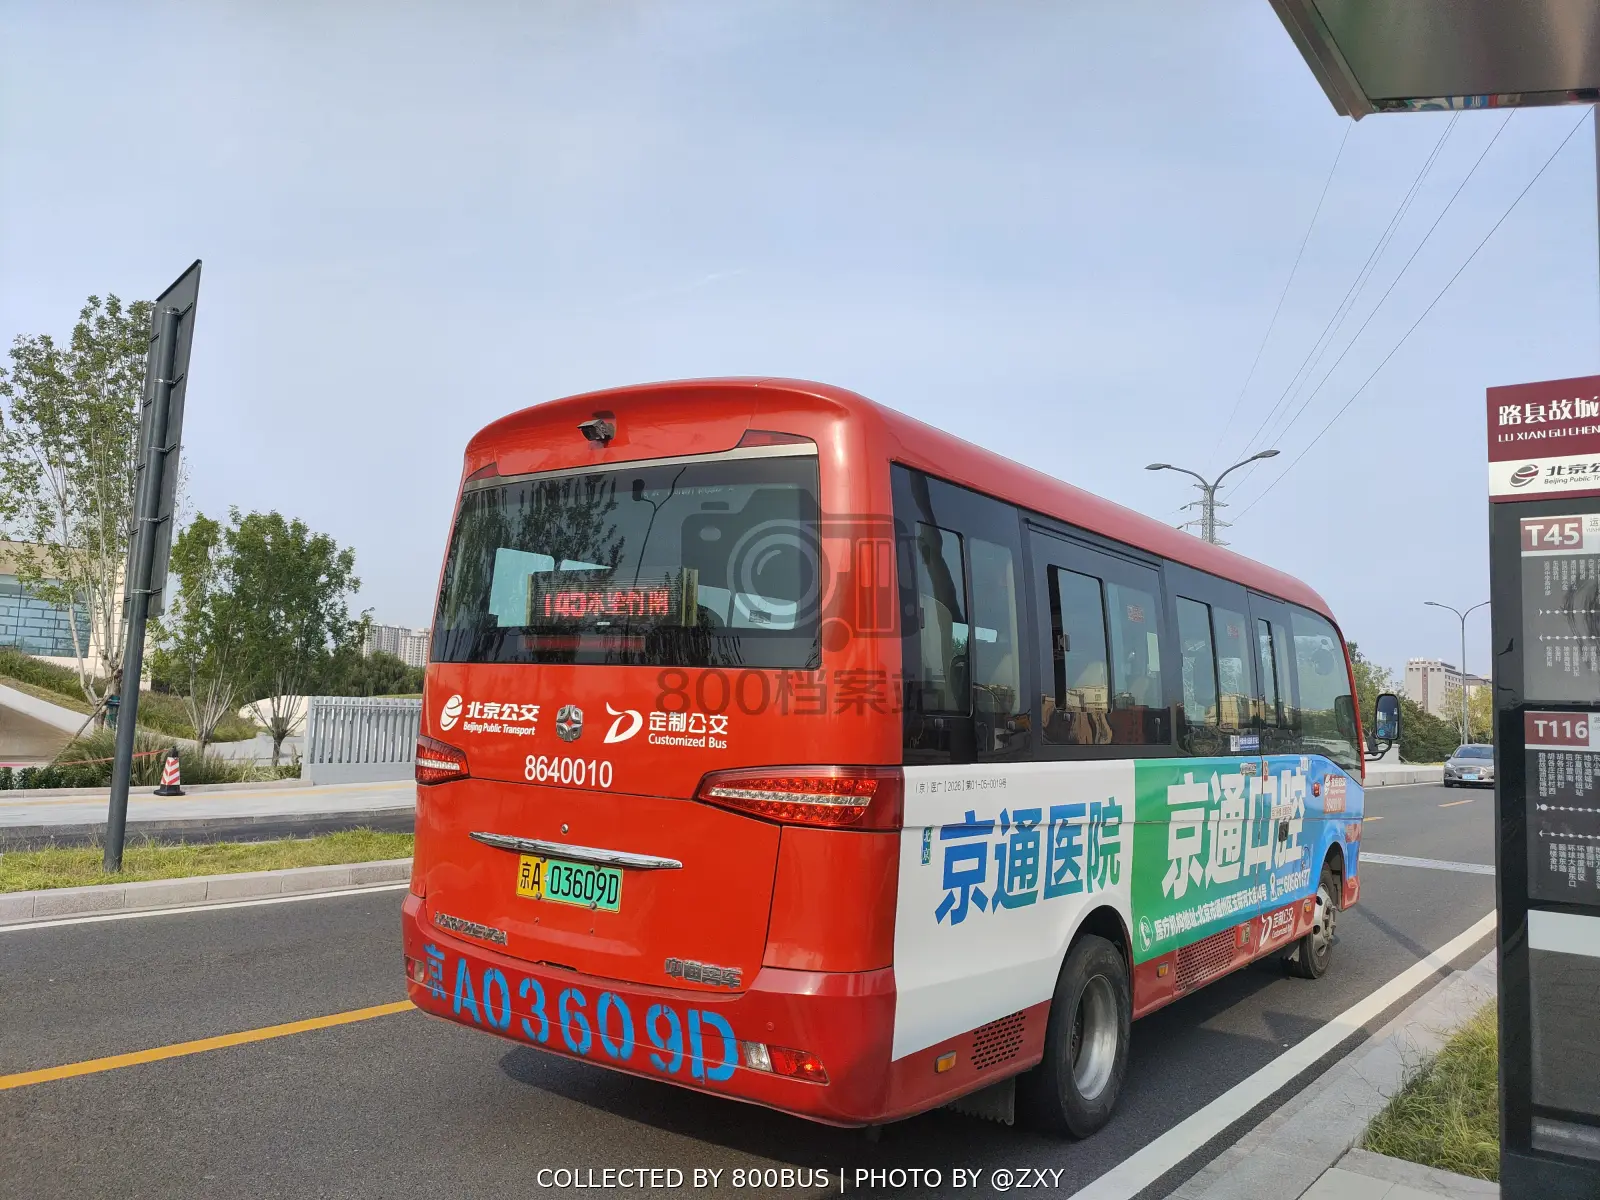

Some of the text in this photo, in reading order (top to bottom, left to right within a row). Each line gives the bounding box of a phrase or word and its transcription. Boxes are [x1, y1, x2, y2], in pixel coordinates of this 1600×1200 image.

[1498, 433, 1514, 443] LU
[1517, 430, 1546, 441] XIAN
[1549, 428, 1566, 438] GU
[1544, 477, 1568, 485] Beijing
[1569, 475, 1591, 483] Public
[1525, 522, 1580, 547] T45
[465, 701, 541, 722] 北京公交
[648, 710, 728, 735] 定制公交
[463, 721, 535, 736] Beijing Public Transport
[1534, 719, 1588, 739] T116
[648, 733, 727, 749] Customized Bus
[524, 754, 613, 788] 8640010
[1161, 766, 1307, 899] 京通口腔
[934, 796, 1123, 926] 京通医院
[423, 943, 739, 1082] 京A03609D
